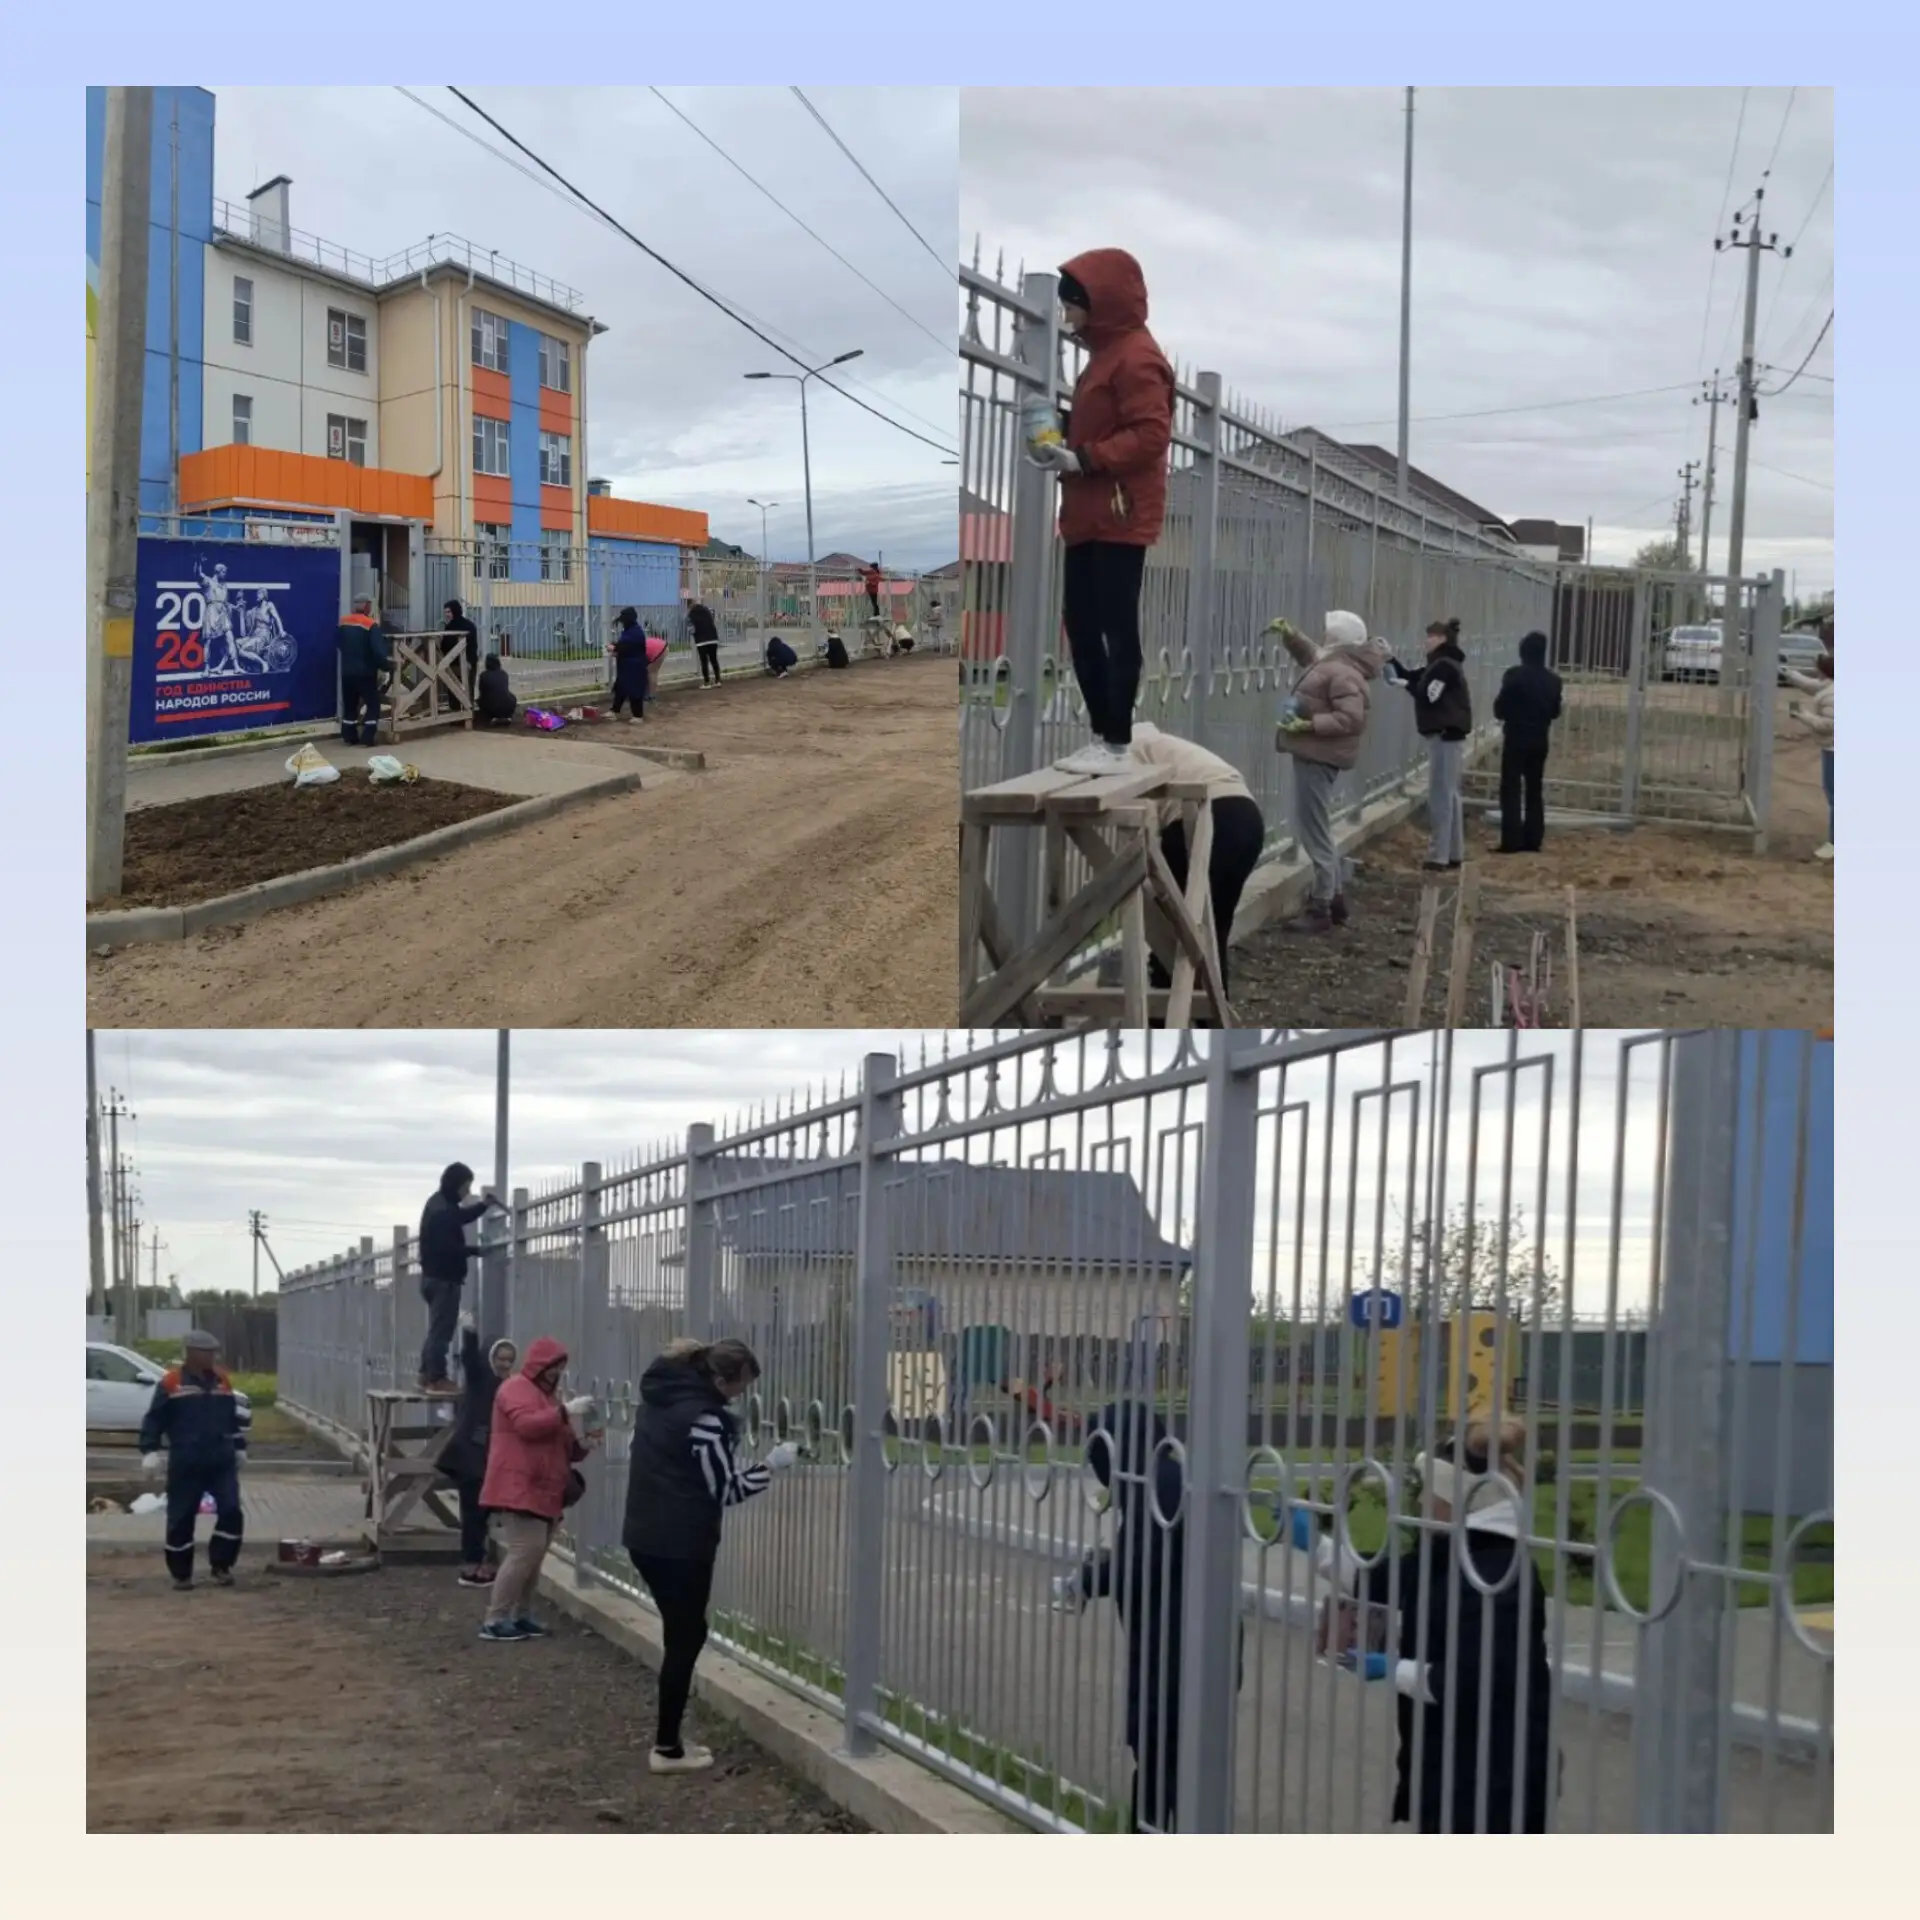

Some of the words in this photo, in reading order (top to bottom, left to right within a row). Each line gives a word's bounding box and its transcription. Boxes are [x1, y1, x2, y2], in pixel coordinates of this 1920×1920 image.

[156, 591, 206, 630] 20
[156, 631, 204, 669] 26
[155, 695, 218, 710] НАРОДОВ
[221, 690, 271, 704] РОССИИ
[156, 685, 183, 696] ГОД
